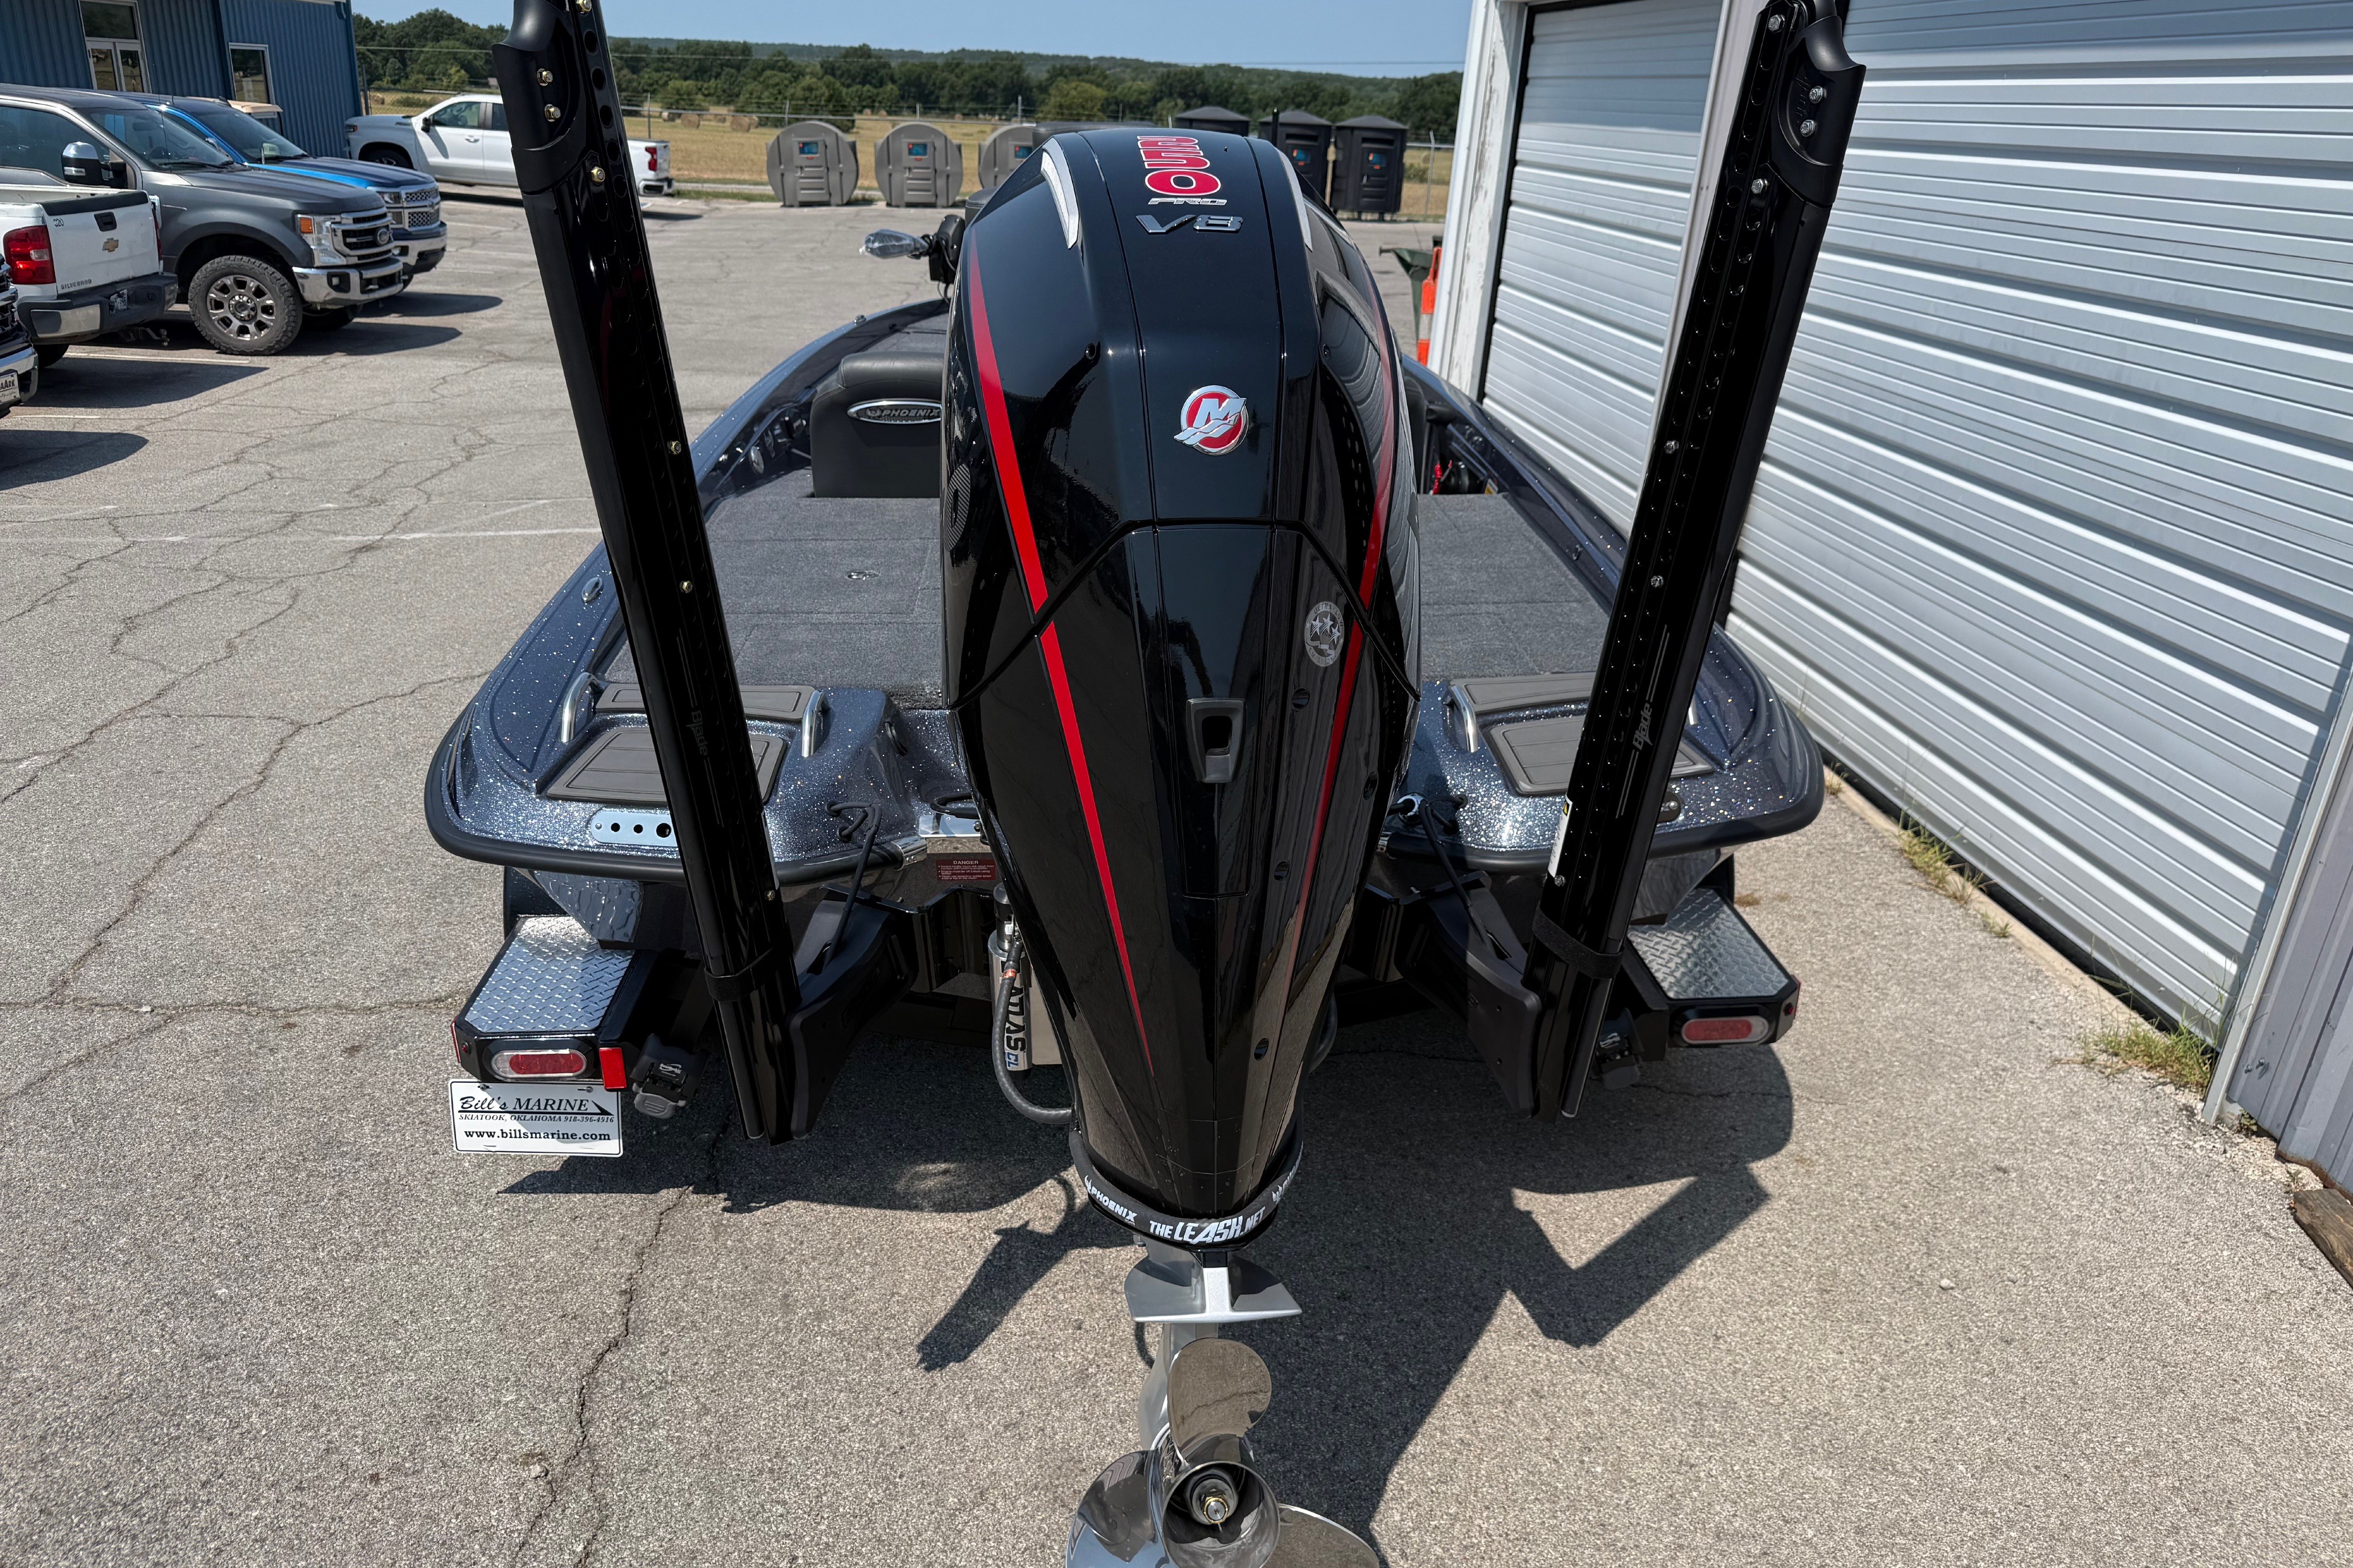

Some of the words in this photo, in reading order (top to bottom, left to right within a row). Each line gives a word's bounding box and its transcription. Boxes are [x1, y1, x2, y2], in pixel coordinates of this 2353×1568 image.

[1136, 136, 1222, 196] 250
[1135, 214, 1243, 234] V8
[61, 279, 92, 290] SILVERADO
[685, 710, 708, 756] Blade
[1633, 703, 1653, 751] Blade
[1006, 986, 1027, 1052] ATLAS
[460, 1096, 509, 1110] Bill's
[513, 1098, 590, 1111] MARINE
[459, 1114, 507, 1122] SKIATOOK,
[464, 1129, 612, 1141] www.billsmarine.com
[1091, 1186, 1138, 1222] PHOENIX
[1149, 1220, 1174, 1239] THE
